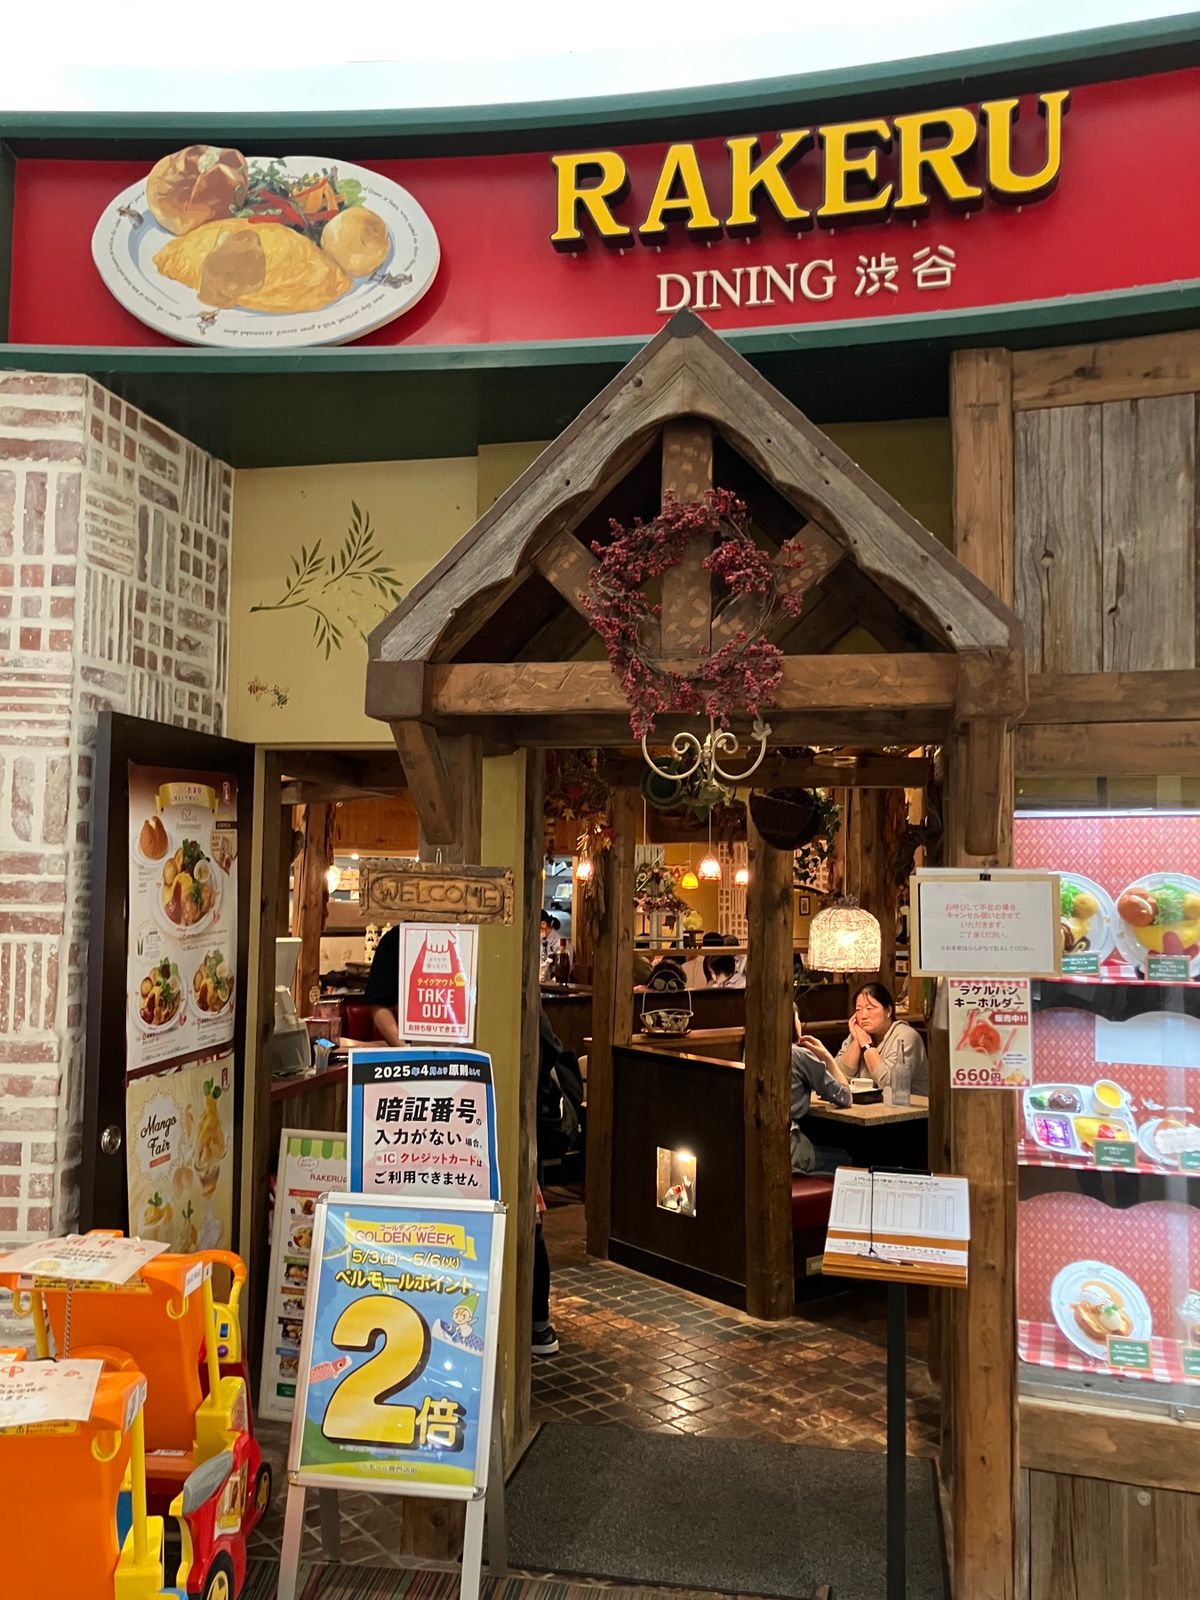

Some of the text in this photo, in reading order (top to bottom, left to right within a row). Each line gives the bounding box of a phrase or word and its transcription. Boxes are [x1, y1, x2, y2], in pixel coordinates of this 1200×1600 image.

[550, 90, 1071, 246] RAKERU
[656, 244, 957, 314] DINING 渋谷
[373, 878, 498, 909] WELCOME
[416, 977, 455, 987] テイクアウト
[416, 988, 455, 1004] TAKE
[954, 997, 1025, 1008] キーホルダー
[422, 1003, 451, 1019] OUT
[374, 1064, 481, 1079] 2025年4月より原則として
[955, 1068, 1001, 1082] 660円
[376, 1096, 482, 1126] 暗証番号の
[140, 1114, 177, 1138] Mango
[147, 1136, 170, 1157] Fair
[380, 1224, 436, 1232] ゴールデンウィーク
[356, 1231, 456, 1246] GOLDEN WEEK
[335, 1269, 474, 1295] ベルモールポイント
